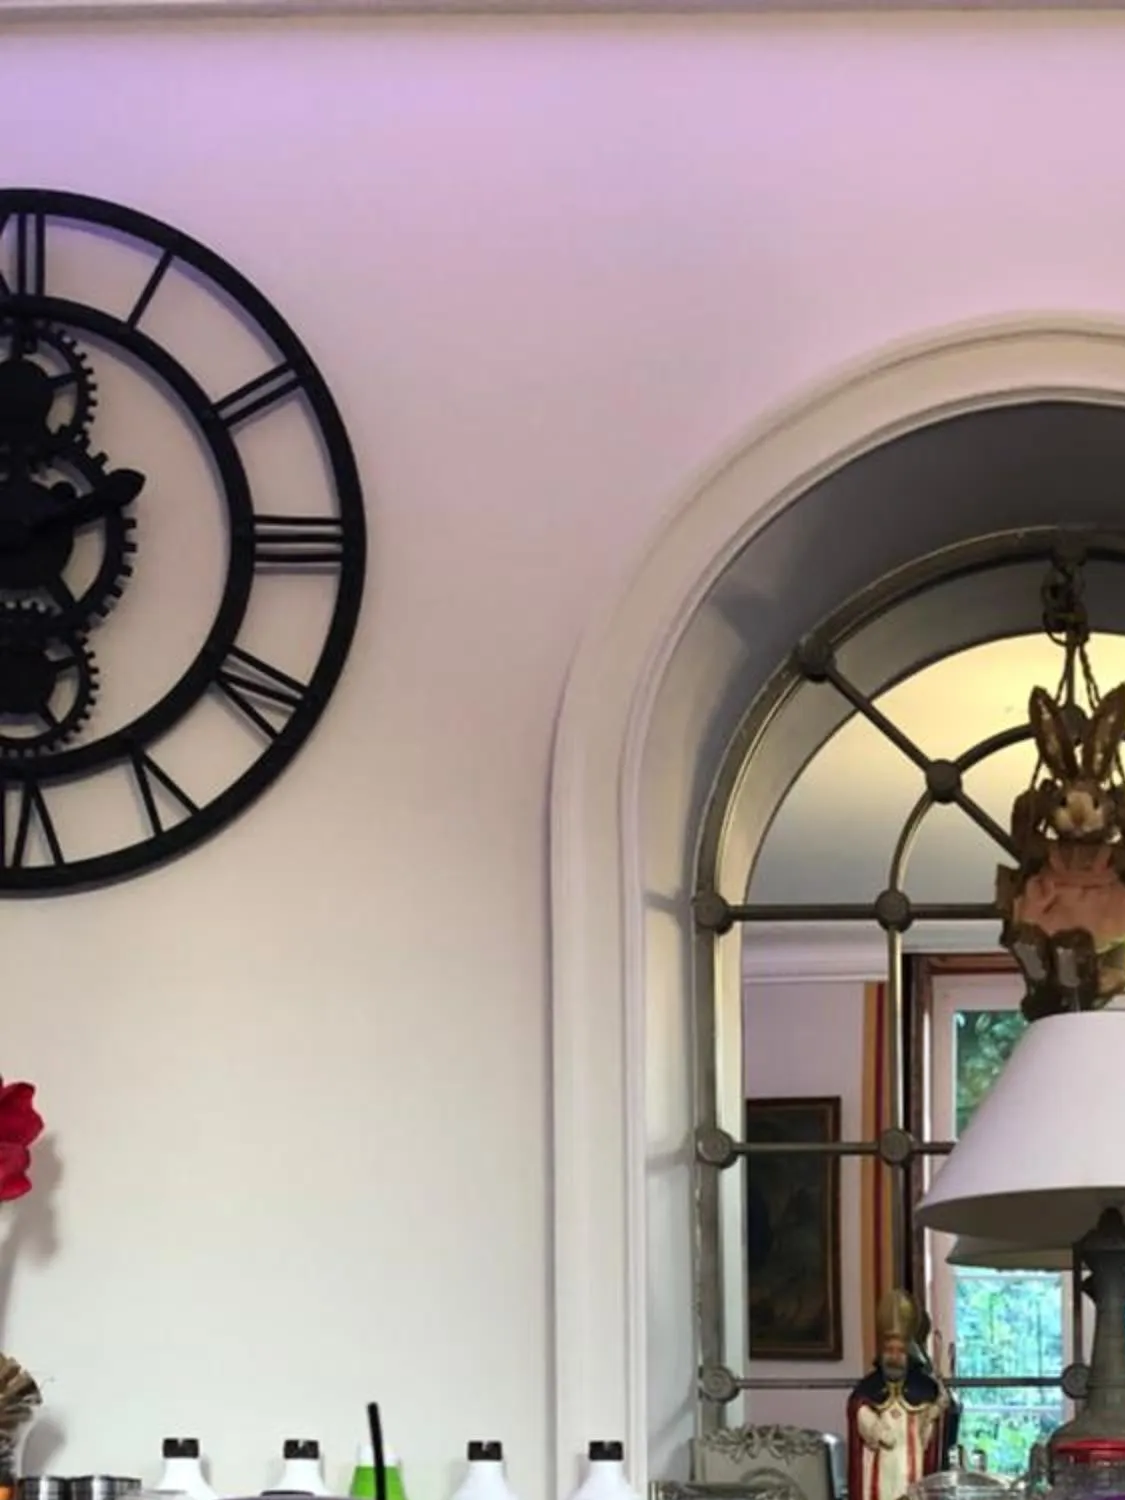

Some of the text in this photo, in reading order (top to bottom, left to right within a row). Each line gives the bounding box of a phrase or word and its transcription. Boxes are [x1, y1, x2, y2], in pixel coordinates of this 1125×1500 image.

[211, 361, 304, 428] II
[252, 514, 344, 564] III
[131, 750, 202, 834] V
